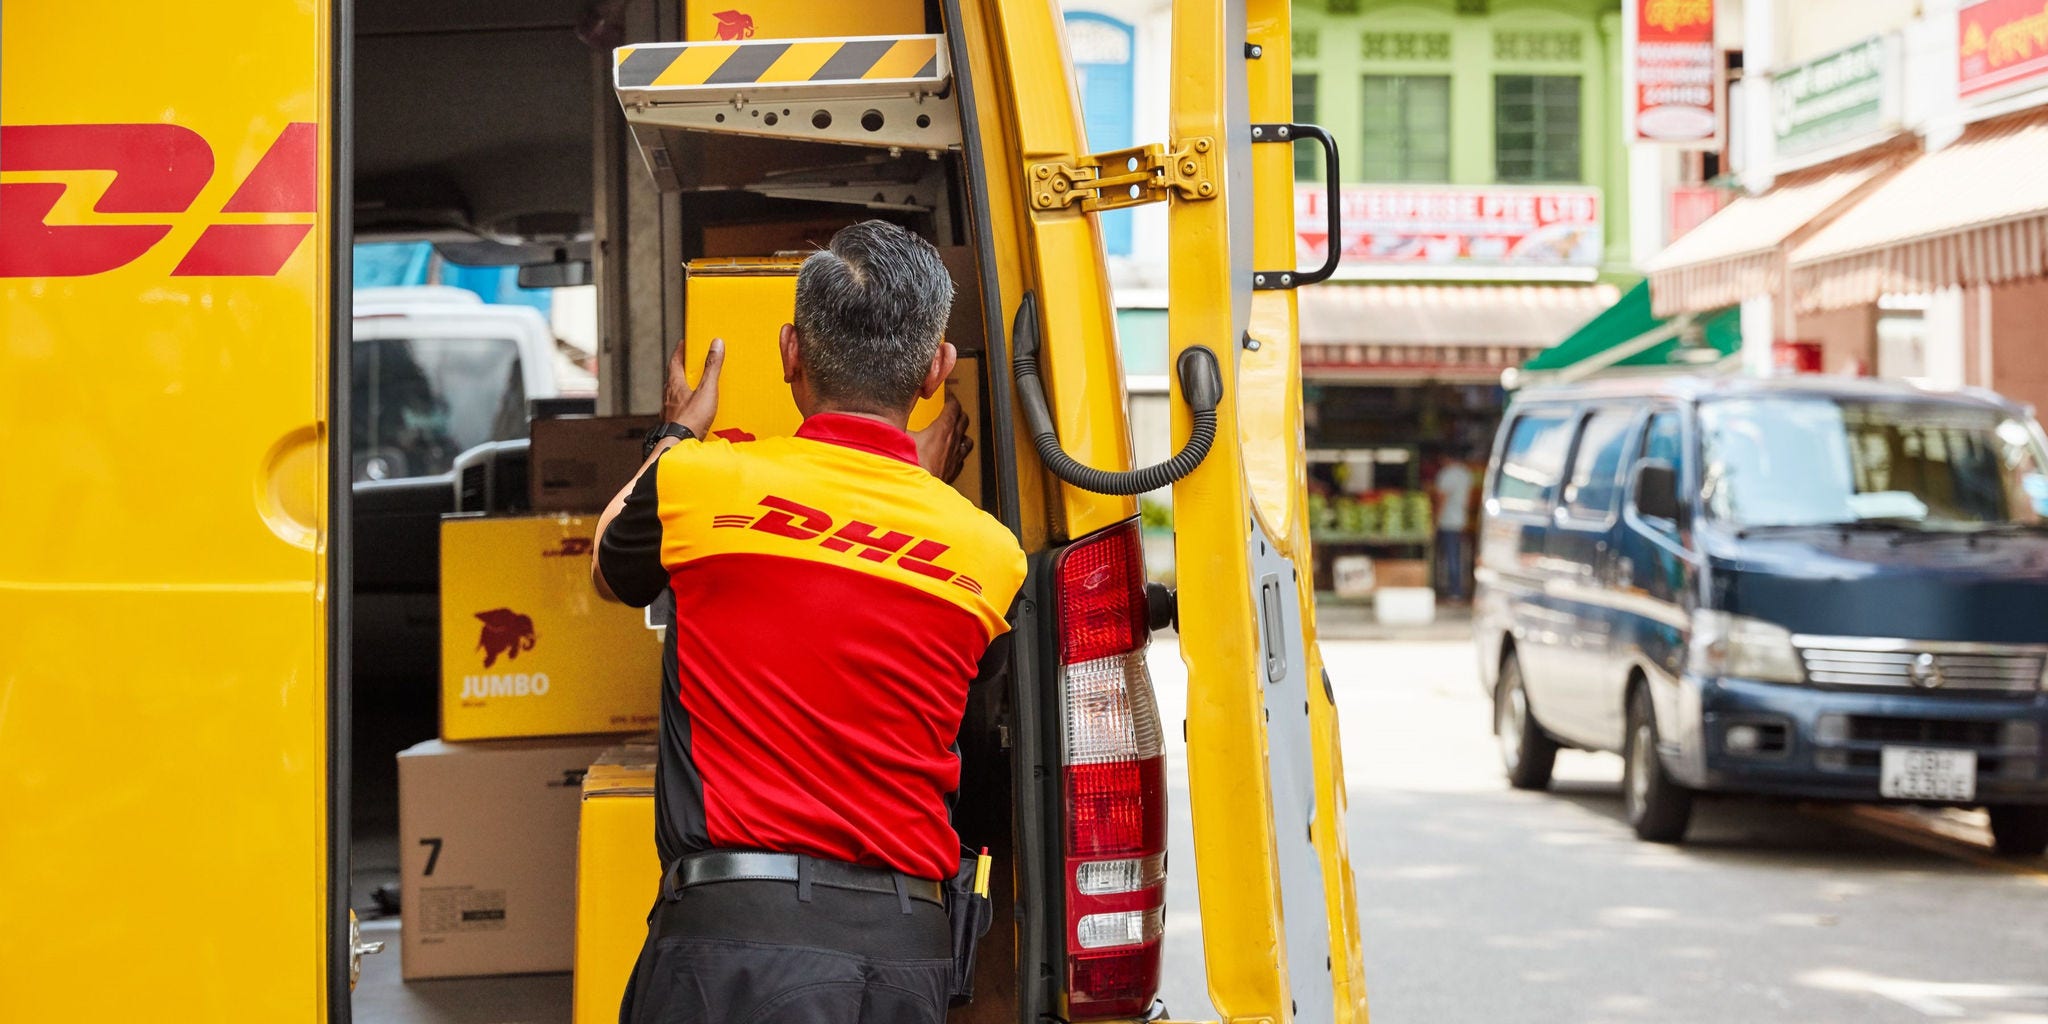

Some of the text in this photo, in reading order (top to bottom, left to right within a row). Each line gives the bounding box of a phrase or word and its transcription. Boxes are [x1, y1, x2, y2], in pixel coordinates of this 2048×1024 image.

[750, 495, 957, 582] DHL
[461, 672, 550, 699] JUMBO
[419, 837, 443, 876] 7
